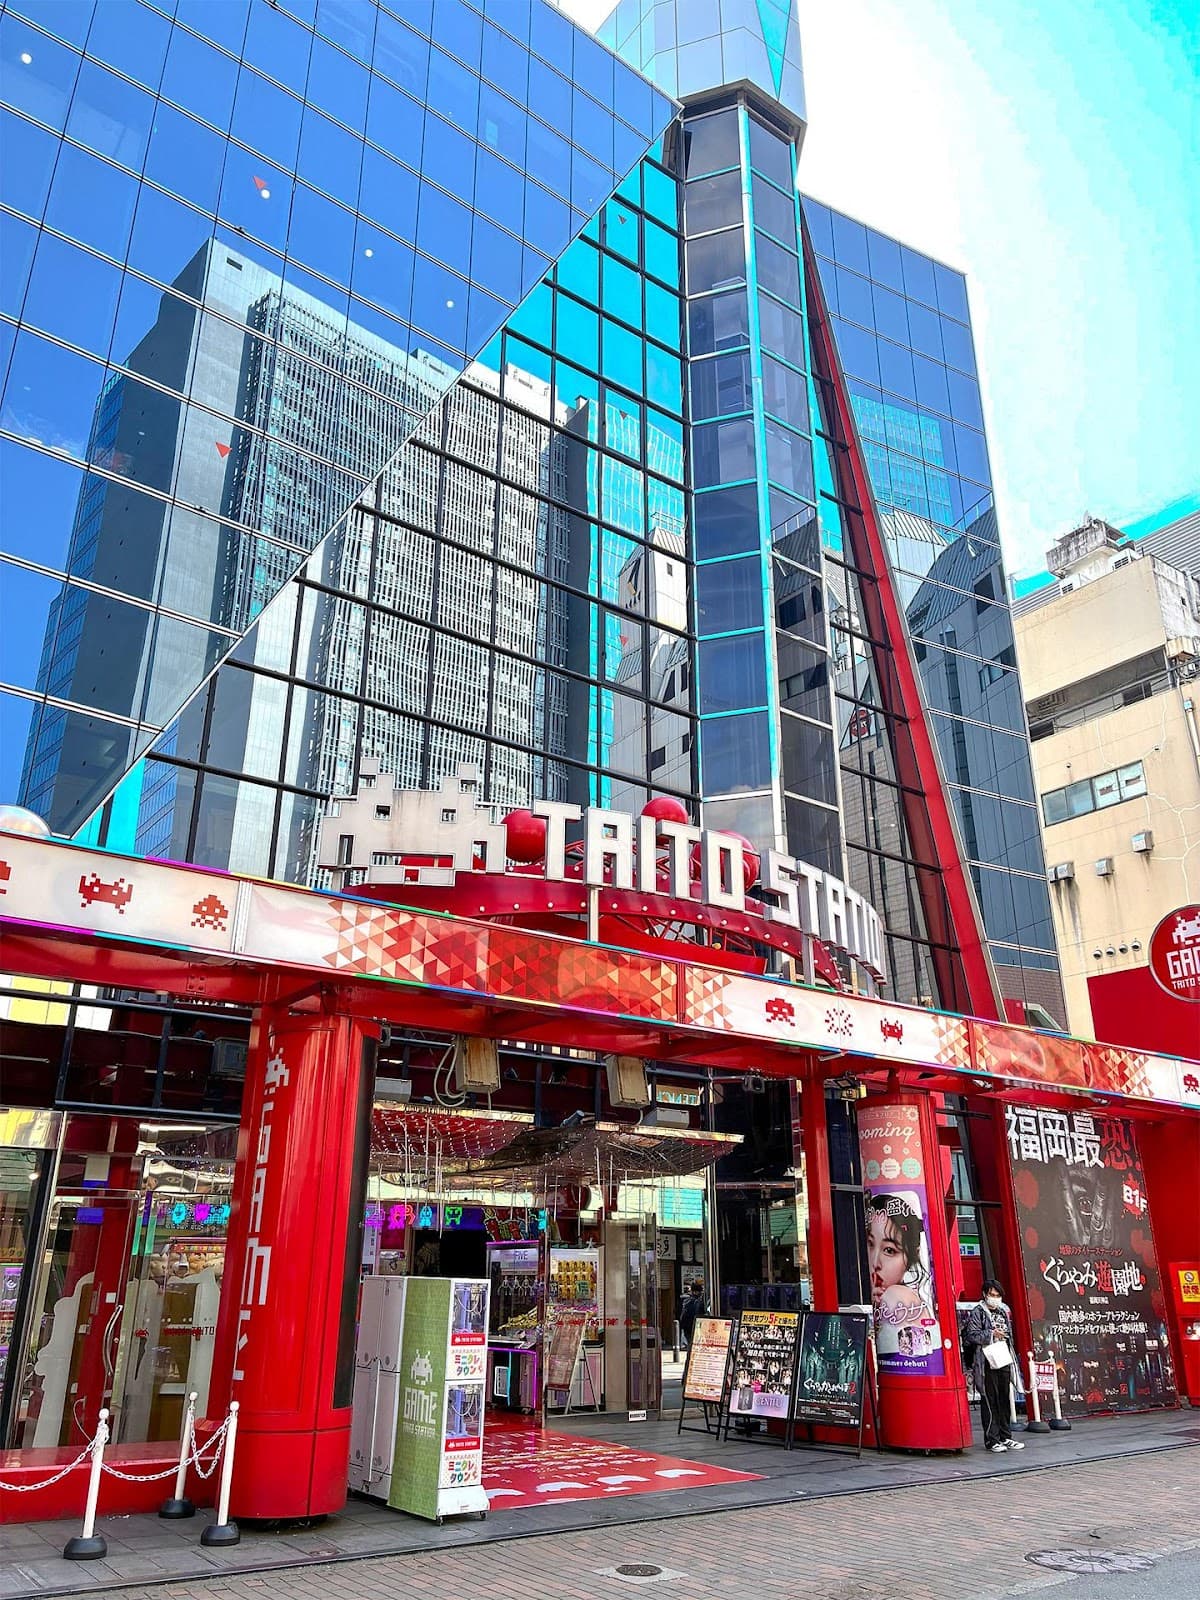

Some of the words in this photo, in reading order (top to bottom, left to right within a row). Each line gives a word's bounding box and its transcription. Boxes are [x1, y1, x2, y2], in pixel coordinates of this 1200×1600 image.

[532, 799, 746, 913] TAITO
[1172, 977, 1196, 990] TAITO
[1122, 1183, 1148, 1213] B1F
[403, 1386, 438, 1425] GAME
